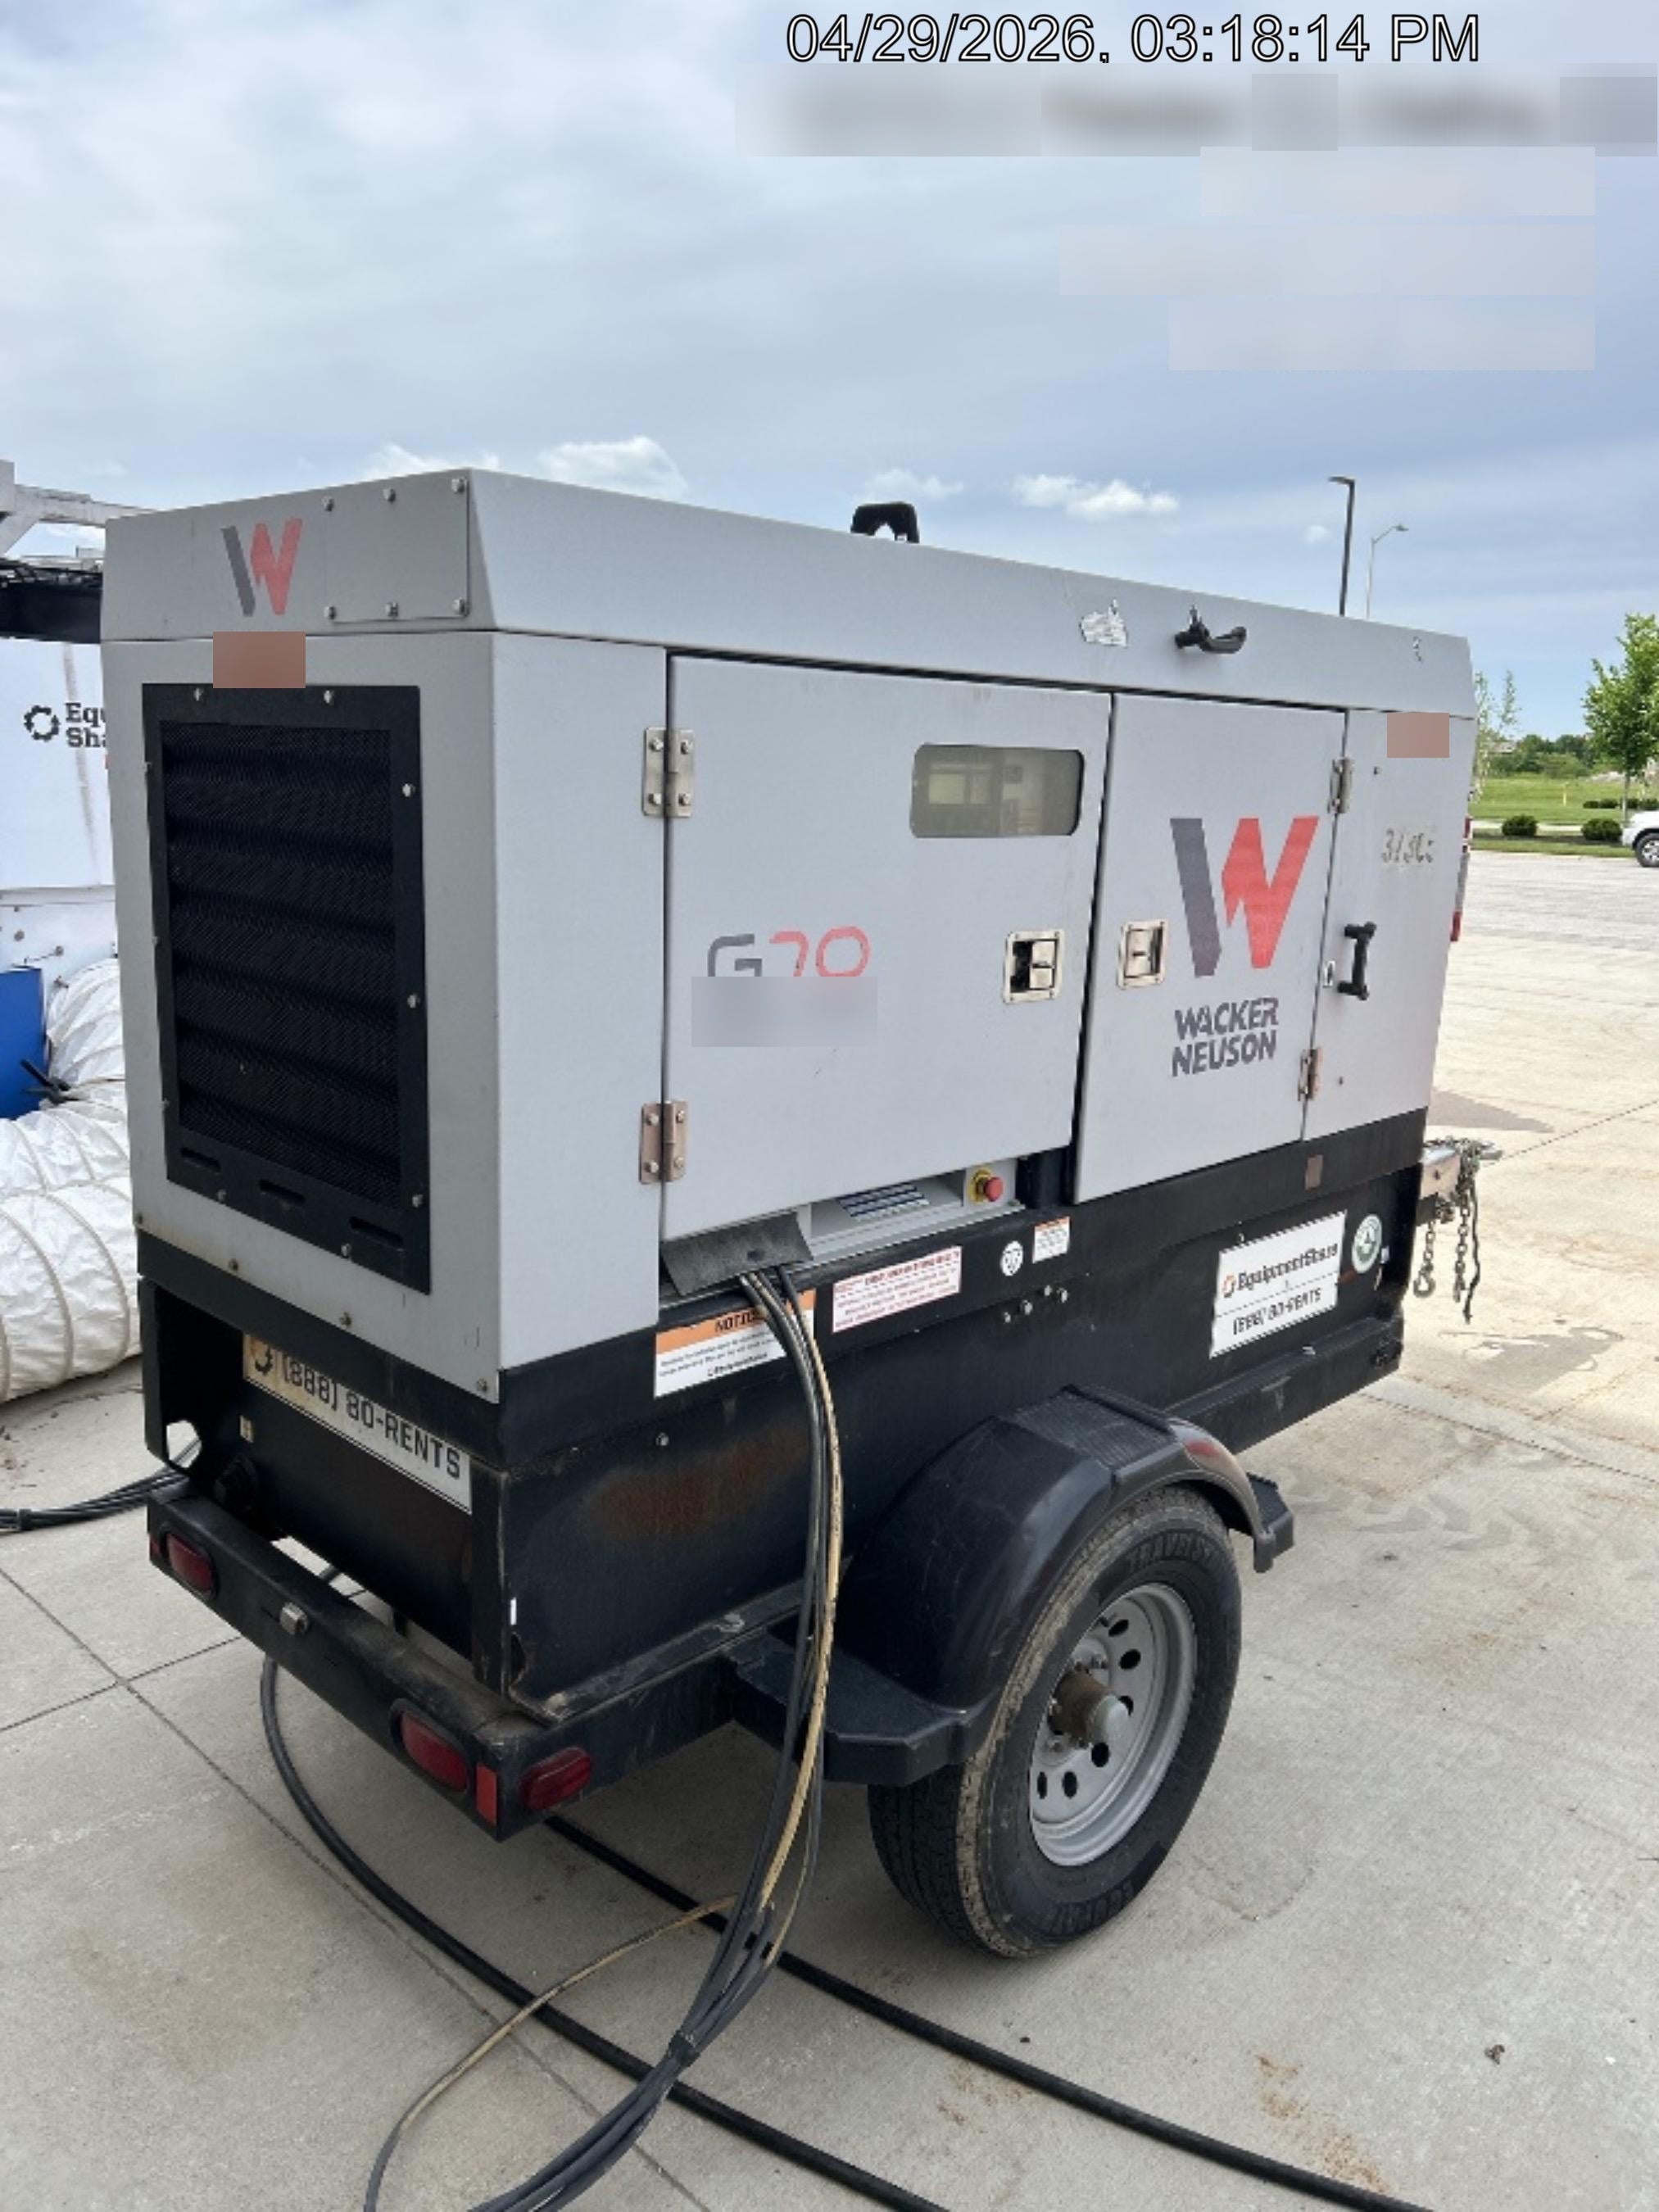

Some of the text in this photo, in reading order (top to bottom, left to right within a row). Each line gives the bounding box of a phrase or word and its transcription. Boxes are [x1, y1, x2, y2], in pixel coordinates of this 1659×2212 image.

[1174, 997, 1279, 1040] WACKER
[1172, 1029, 1277, 1077] NEUSON
[282, 1353, 460, 1480] (888) 80-RENTS
